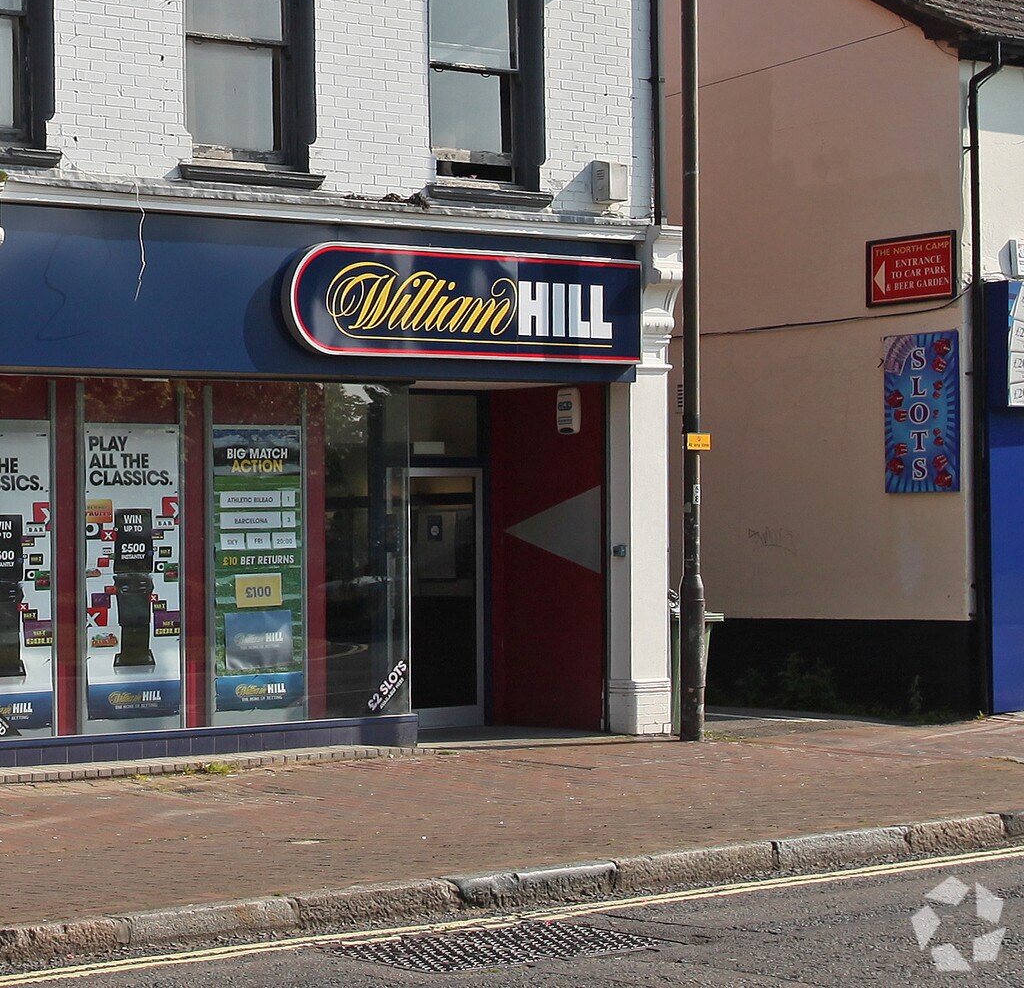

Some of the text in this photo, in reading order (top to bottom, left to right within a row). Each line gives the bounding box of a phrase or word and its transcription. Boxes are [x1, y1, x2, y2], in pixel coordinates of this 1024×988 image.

[874, 240, 950, 257] THE NORTH CAMP
[894, 254, 942, 268] ENTRANCE
[890, 265, 947, 279] TO CAR PARK
[885, 276, 950, 292] & BEER GARDEN
[326, 261, 612, 340] William HILL
[909, 347, 930, 480] SLOTS
[89, 436, 128, 451] PLAY
[227, 448, 288, 459] BIG MATCH
[89, 453, 149, 469] ALL THE
[231, 459, 283, 473] ACTION
[89, 470, 173, 486] CLASSICS.
[124, 515, 142, 524] WIN
[121, 543, 145, 553] £500
[223, 554, 295, 566] £10 BET RETURNS
[245, 586, 271, 598] £100
[265, 632, 283, 642] HILL
[267, 683, 286, 694] HILL
[367, 660, 407, 711] £2 SLOTS
[142, 690, 161, 701] HILL
[12, 702, 33, 713] HILL
